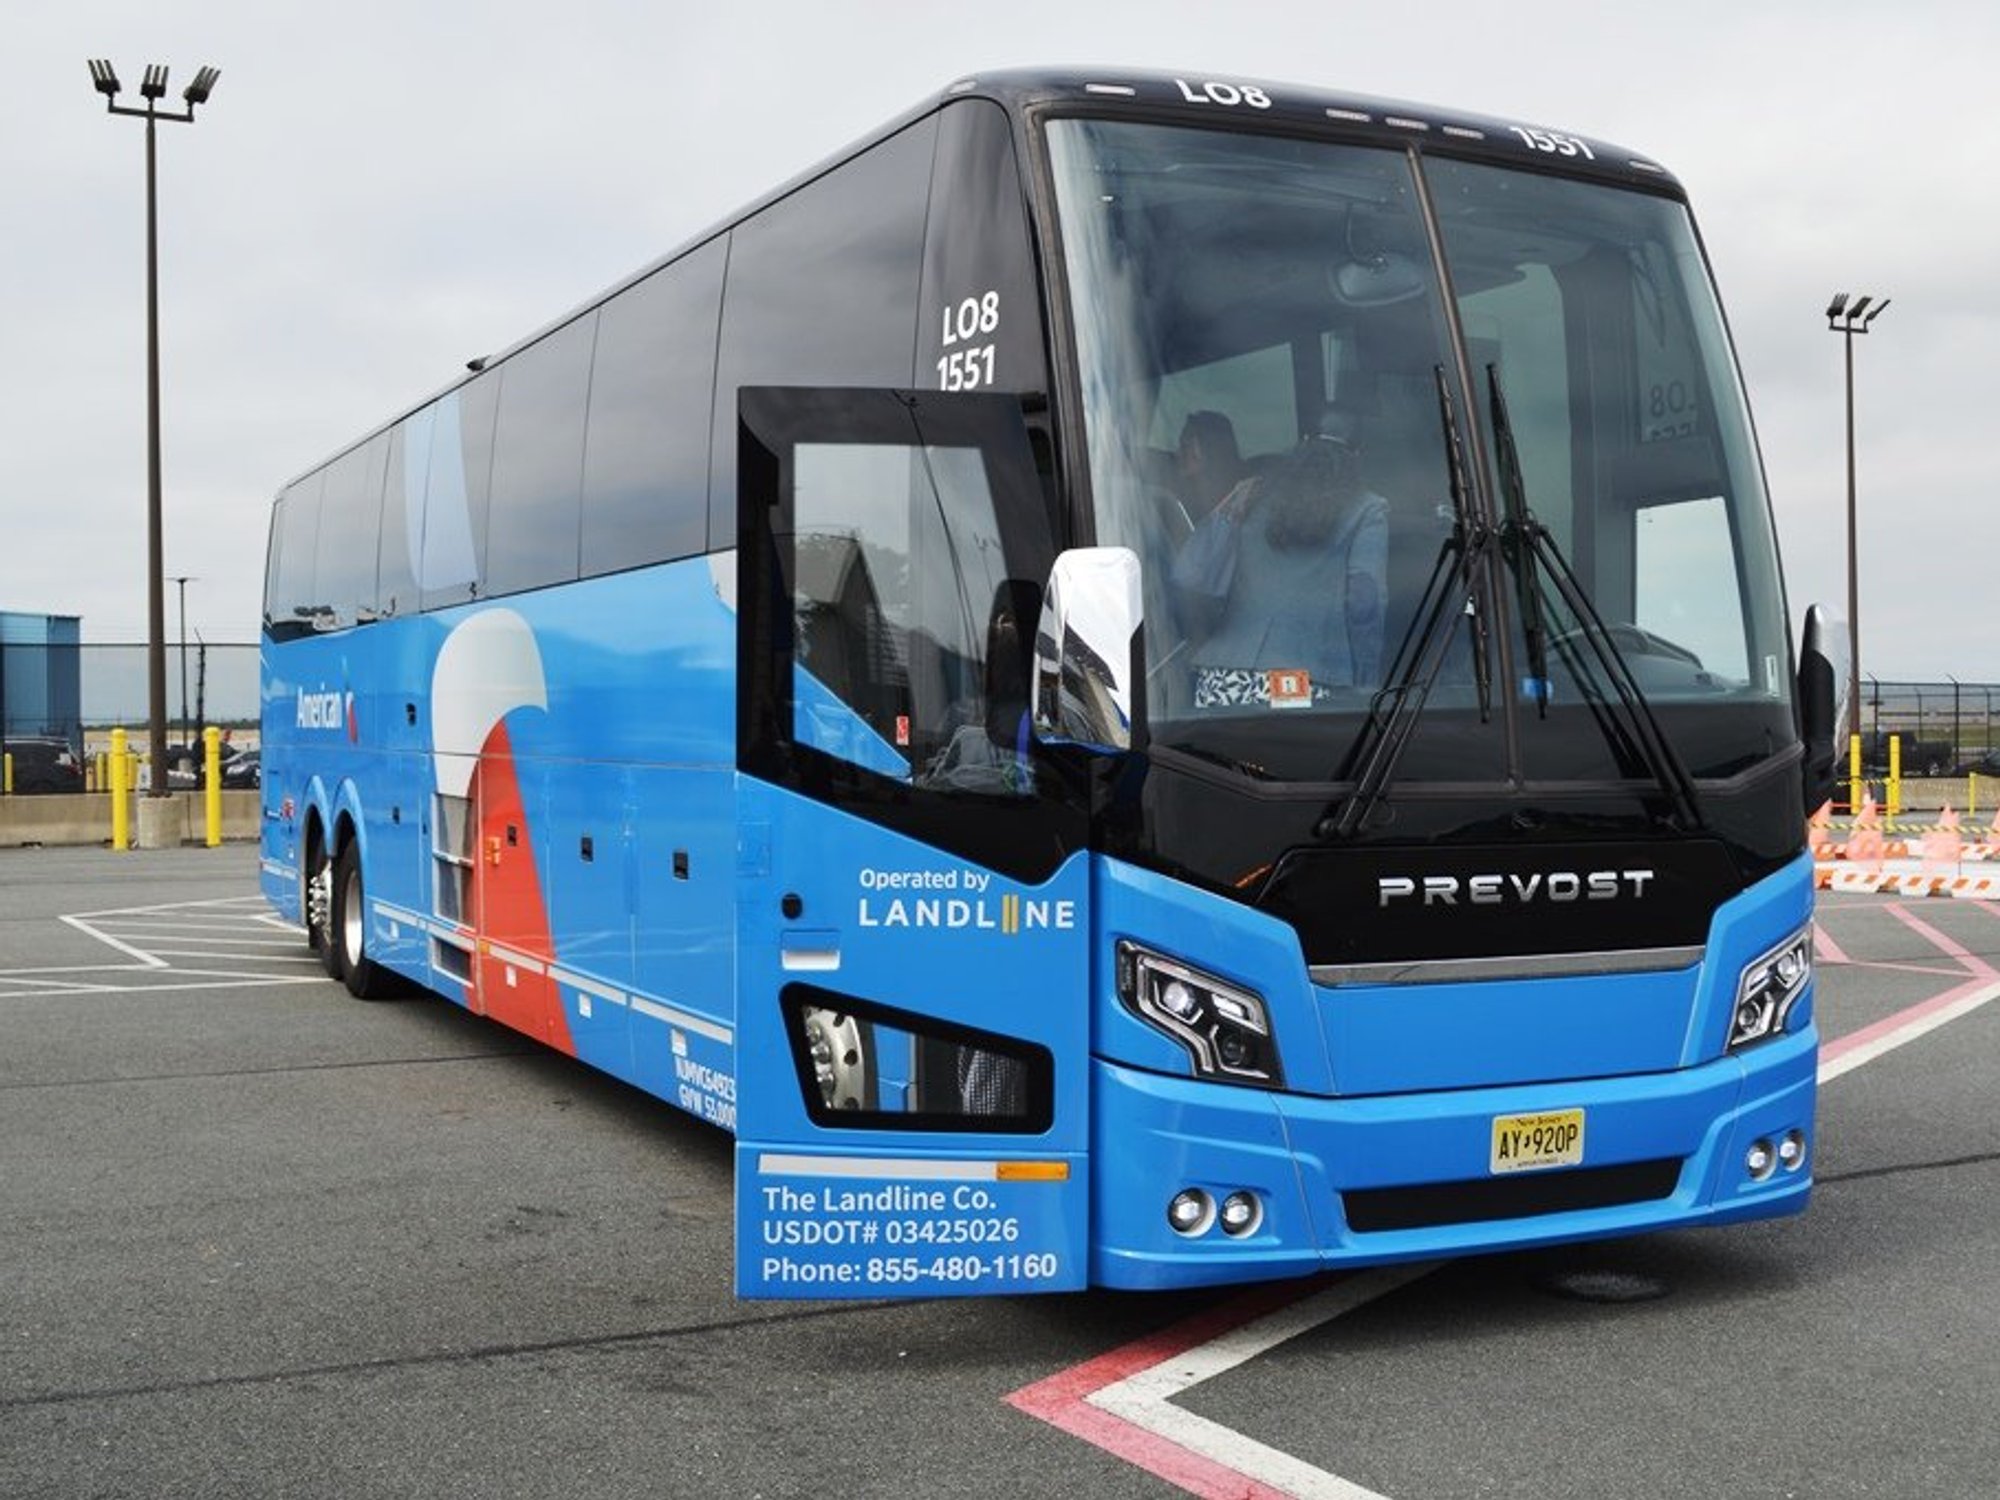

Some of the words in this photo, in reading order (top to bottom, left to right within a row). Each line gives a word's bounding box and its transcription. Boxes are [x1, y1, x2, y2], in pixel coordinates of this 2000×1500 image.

[1509, 126, 1595, 160] 1551
[937, 344, 995, 391] 1551
[859, 868, 958, 890] Operated
[963, 868, 990, 892] by
[1379, 870, 1654, 907] PREVOST
[763, 1186, 816, 1211] The
[823, 1186, 946, 1212] Landline
[953, 1185, 997, 1211] Co.
[763, 1220, 878, 1244] USDOT#
[885, 1218, 1019, 1244] 03425026
[763, 1257, 861, 1281] Phone:
[867, 1252, 1057, 1281] 855-480-1160
